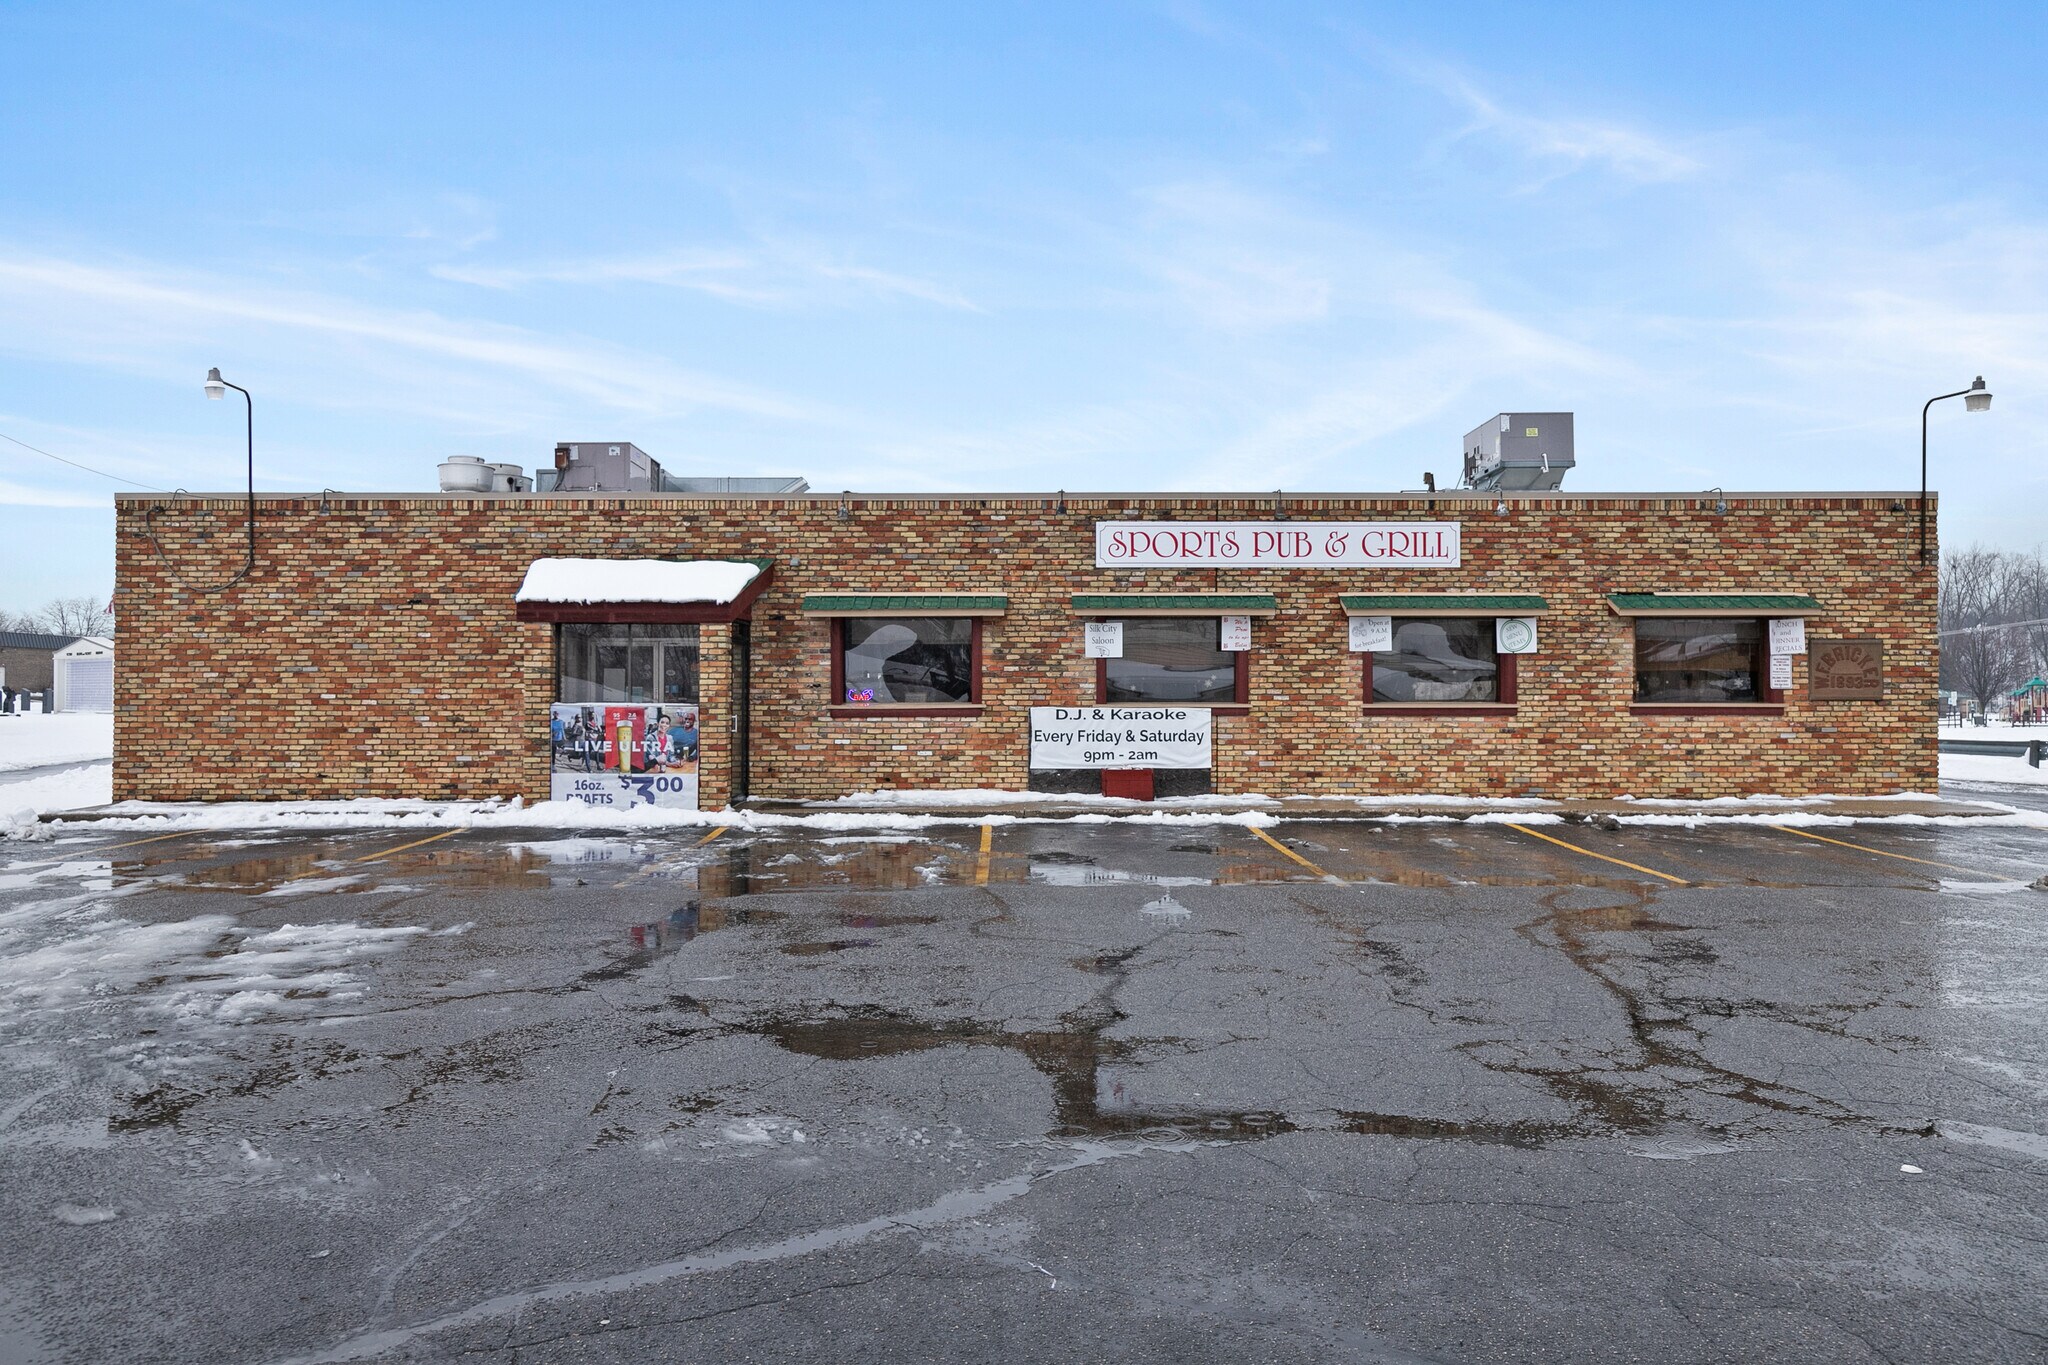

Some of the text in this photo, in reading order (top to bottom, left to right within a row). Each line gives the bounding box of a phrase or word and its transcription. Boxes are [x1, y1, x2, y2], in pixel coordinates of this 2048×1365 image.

[1108, 530, 1450, 559] SPORTS PUB & GRILL
[1089, 624, 1117, 635] Silk City
[1091, 636, 1115, 645] Saloon
[1055, 708, 1187, 720] D.J. & Karaoke
[1034, 729, 1205, 745] Every Friday & Saturday
[574, 740, 613, 752] LIVE
[1083, 750, 1115, 763] 9pm
[1128, 750, 1158, 760] 2am
[574, 780, 605, 791] 16oz.
